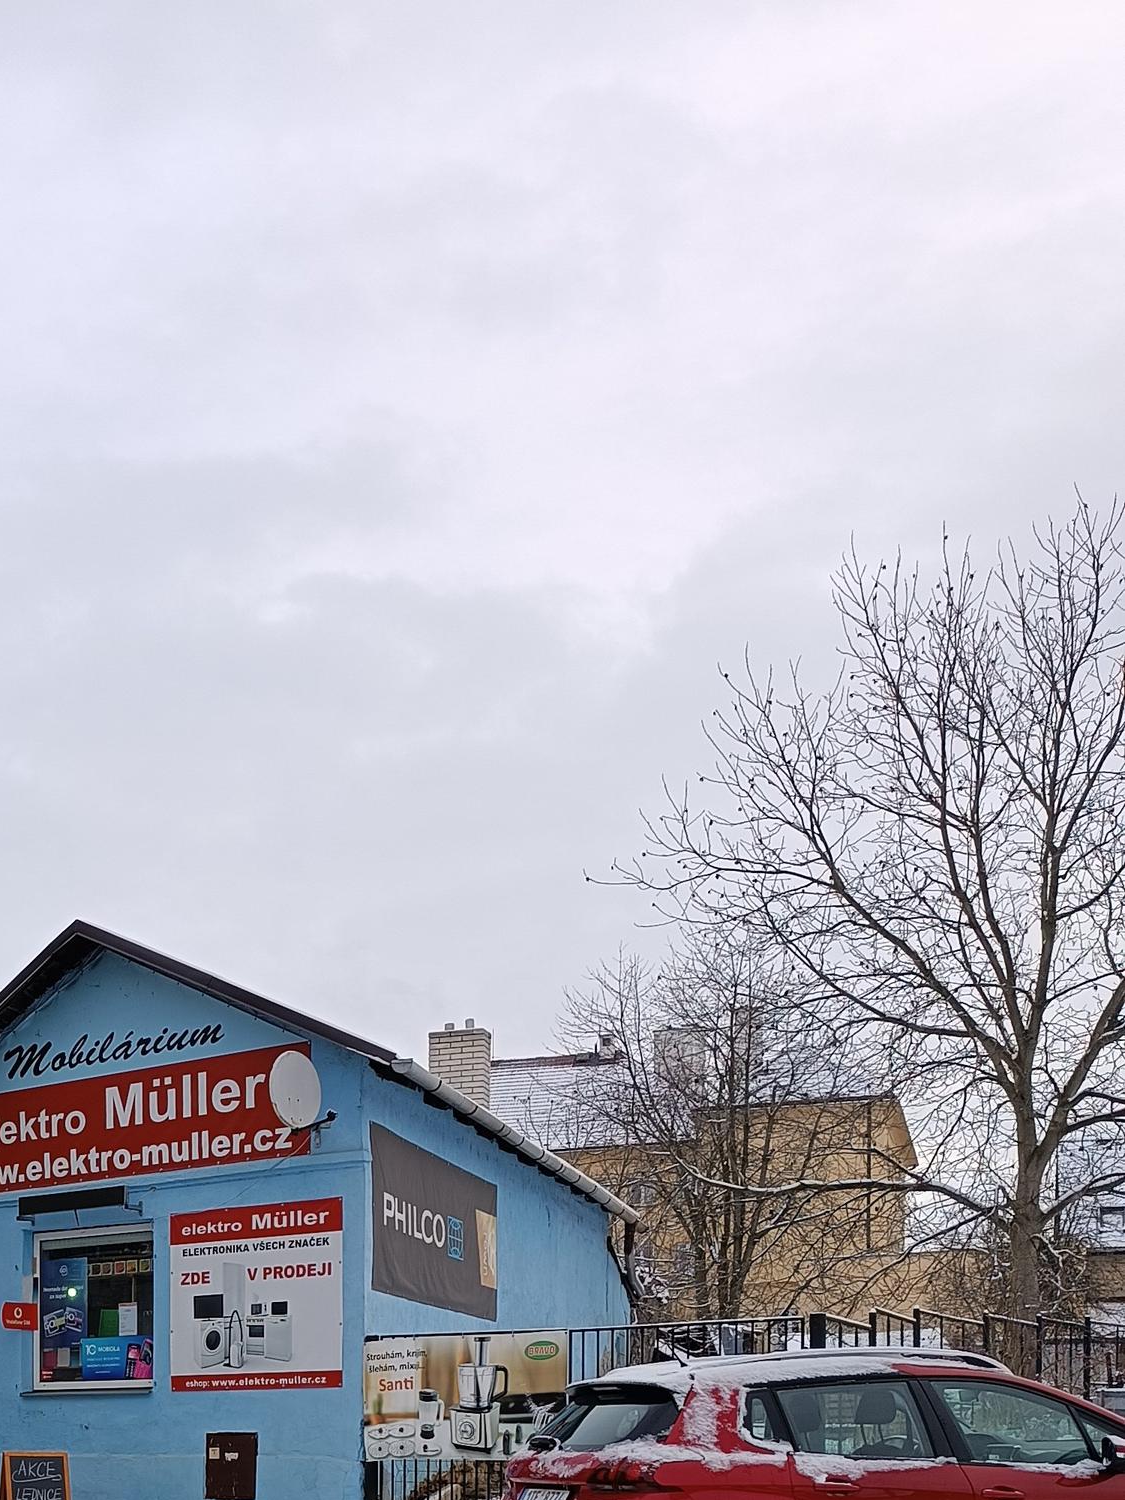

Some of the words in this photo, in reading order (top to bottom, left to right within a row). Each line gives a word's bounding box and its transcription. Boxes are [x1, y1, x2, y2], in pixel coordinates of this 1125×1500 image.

[3, 1021, 224, 1080] Mobilárium
[105, 1071, 266, 1131] Müller
[181, 1221, 243, 1237] elektro
[251, 1209, 330, 1230] Müller
[383, 1191, 446, 1248] PHILCO
[182, 1244, 250, 1257] ELEKTRONIKA
[252, 1239, 286, 1252] VŠECH
[288, 1236, 330, 1249] ZNAČEK
[180, 1271, 211, 1286] ZDE
[247, 1268, 258, 1281] V
[263, 1262, 332, 1280] PRODEJI
[366, 1351, 405, 1361] Strouhám,
[529, 1346, 555, 1356] BRAVO
[186, 1379, 210, 1389] eshop:
[211, 1375, 326, 1388] www.elektro-muller.cz
[379, 1376, 414, 1392] Santi
[18, 1460, 56, 1478] AKCE
